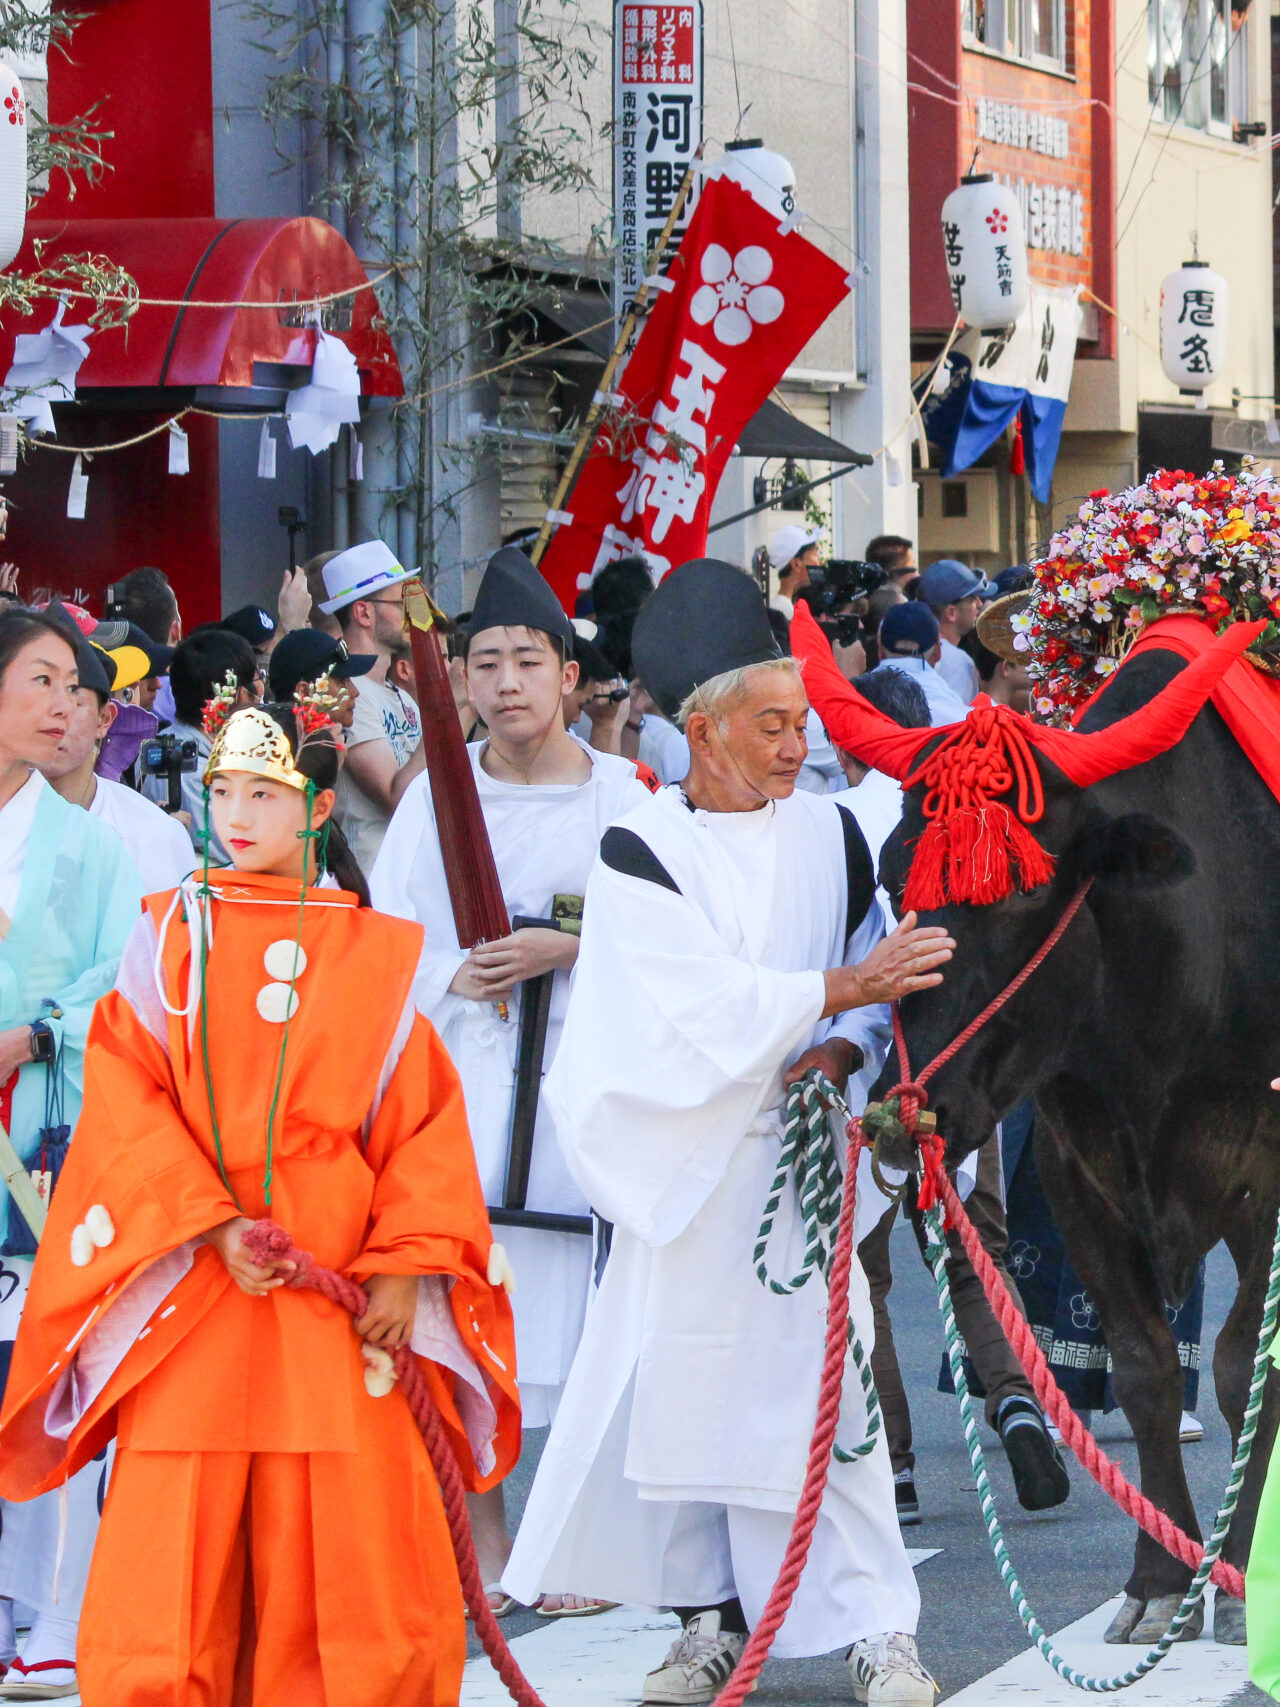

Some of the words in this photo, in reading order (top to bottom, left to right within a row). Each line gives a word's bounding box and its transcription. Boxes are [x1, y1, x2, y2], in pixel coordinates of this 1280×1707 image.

[641, 8, 658, 82] 整形外科
[661, 8, 676, 82] リウマチ科
[678, 9, 692, 82] 内科
